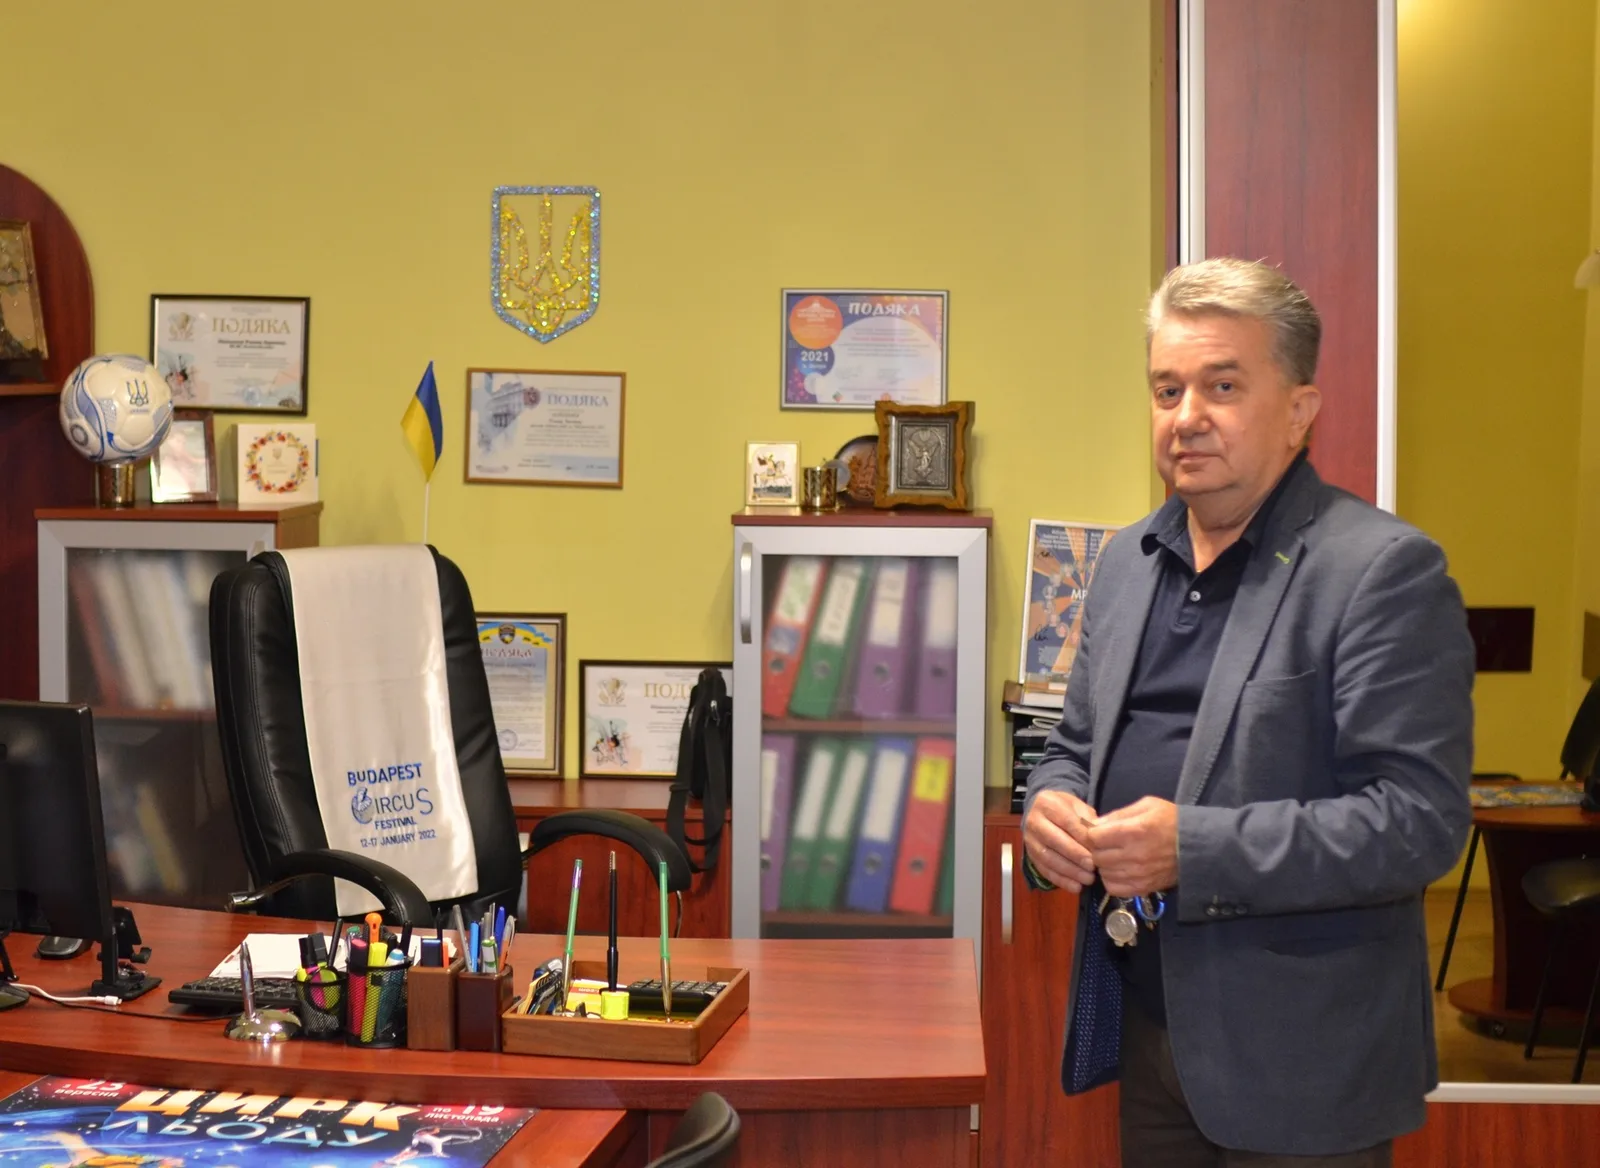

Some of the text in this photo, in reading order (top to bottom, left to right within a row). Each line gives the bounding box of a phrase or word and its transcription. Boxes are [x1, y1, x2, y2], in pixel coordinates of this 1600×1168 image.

[849, 302, 920, 316] ПОДЯКА
[212, 317, 291, 336] ПОДЯКА
[801, 351, 829, 362] 2021
[547, 394, 609, 408] ПОДЯКА
[644, 683, 691, 701] ПОД
[347, 763, 422, 786] BUDAPEST
[374, 816, 417, 830] FESTIVAL
[360, 829, 436, 848] 12-17 JANUARY 2022
[54, 1089, 119, 1097] вересня
[116, 1089, 420, 1131] ЦИРК
[237, 1114, 276, 1125] НА
[425, 1113, 499, 1122] листопада
[99, 1116, 389, 1148] ЛЬОДУ
